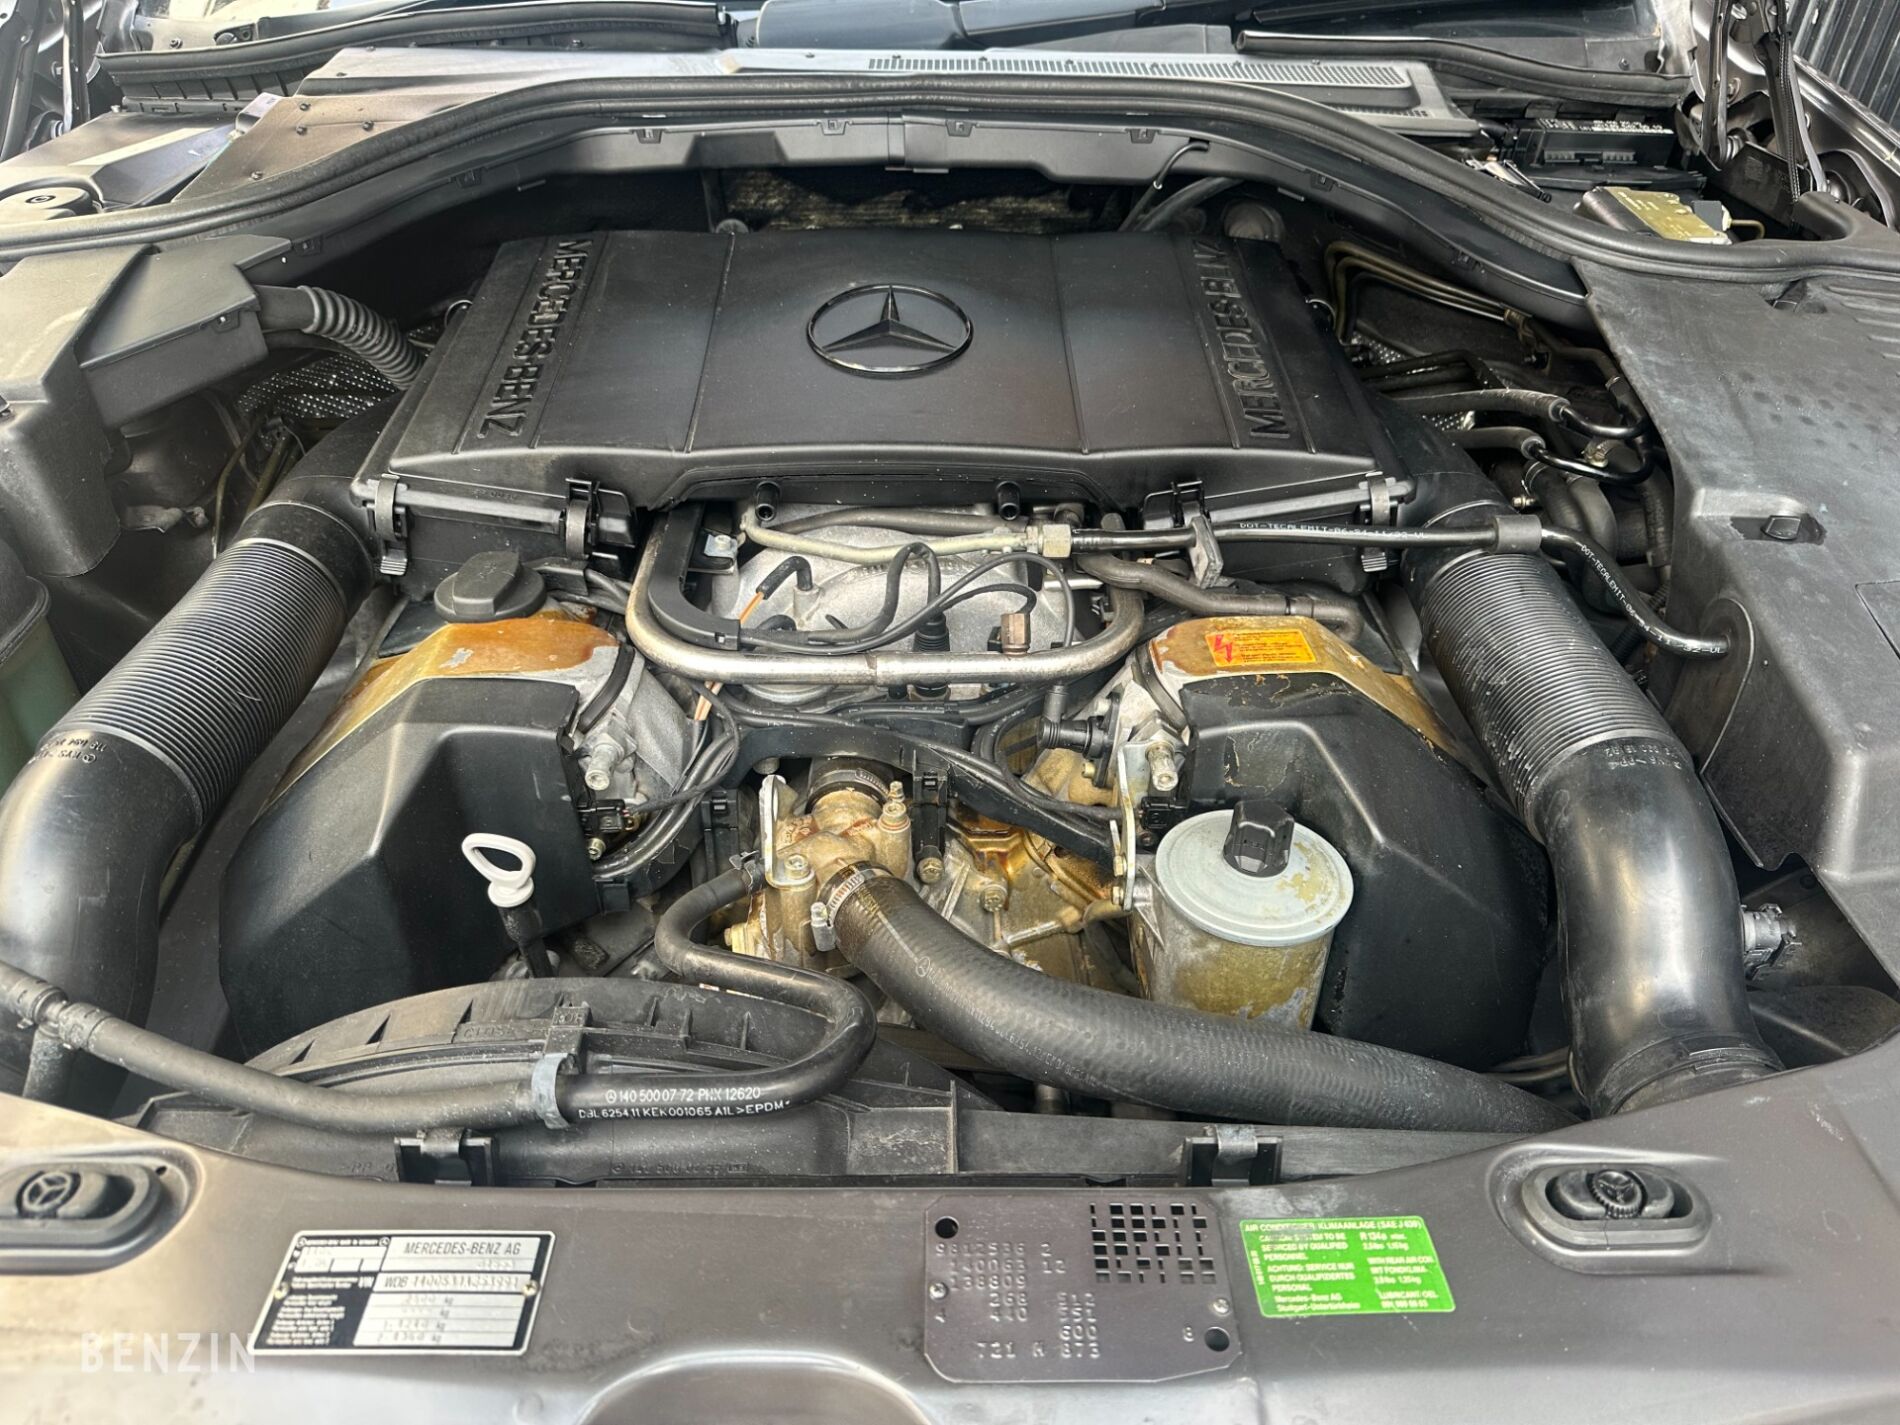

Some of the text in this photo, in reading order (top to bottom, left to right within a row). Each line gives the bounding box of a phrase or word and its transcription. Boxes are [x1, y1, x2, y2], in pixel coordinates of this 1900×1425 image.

[476, 239, 594, 439] MERCEDES-BENZ
[619, 1089, 637, 1103] 140
[639, 1088, 661, 1103] 500
[661, 1088, 677, 1102] 07
[680, 1088, 694, 1102] 72
[725, 1086, 761, 1101] 12620
[668, 1106, 712, 1117] 001065
[403, 1241, 523, 1255] MERCEDES-BENZ AG
[1058, 1324, 1098, 1341] 600
